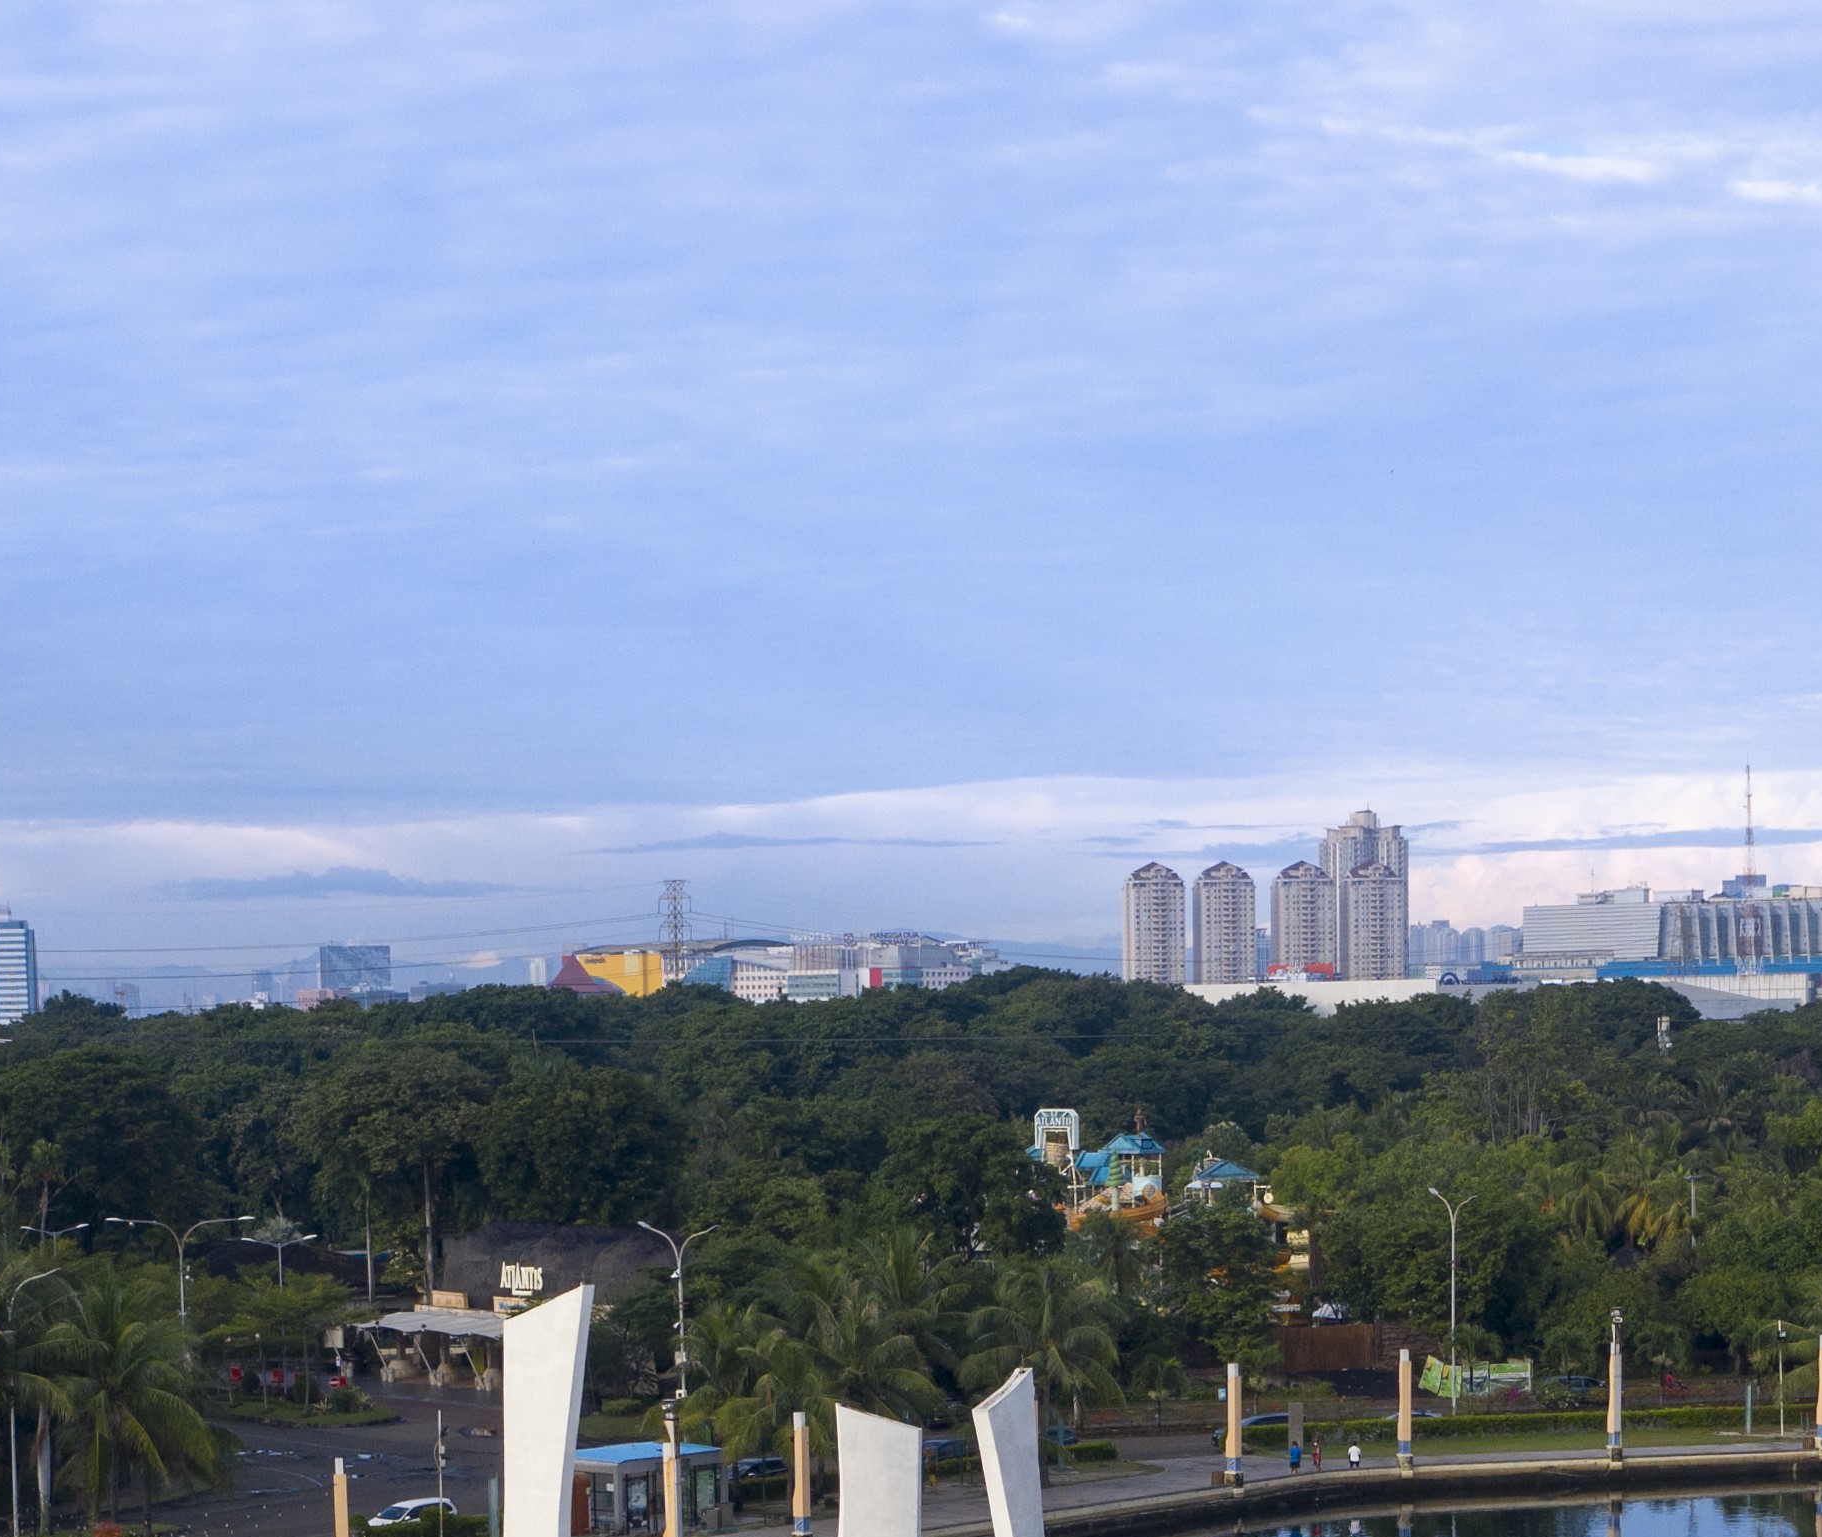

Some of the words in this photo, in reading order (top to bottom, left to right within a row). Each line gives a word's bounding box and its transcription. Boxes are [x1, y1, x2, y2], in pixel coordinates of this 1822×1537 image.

[790, 932, 832, 941] NOVOTEL
[870, 932, 902, 940] MANGGA
[904, 931, 919, 939] DUA
[500, 1261, 543, 1296] ATLANTIS
